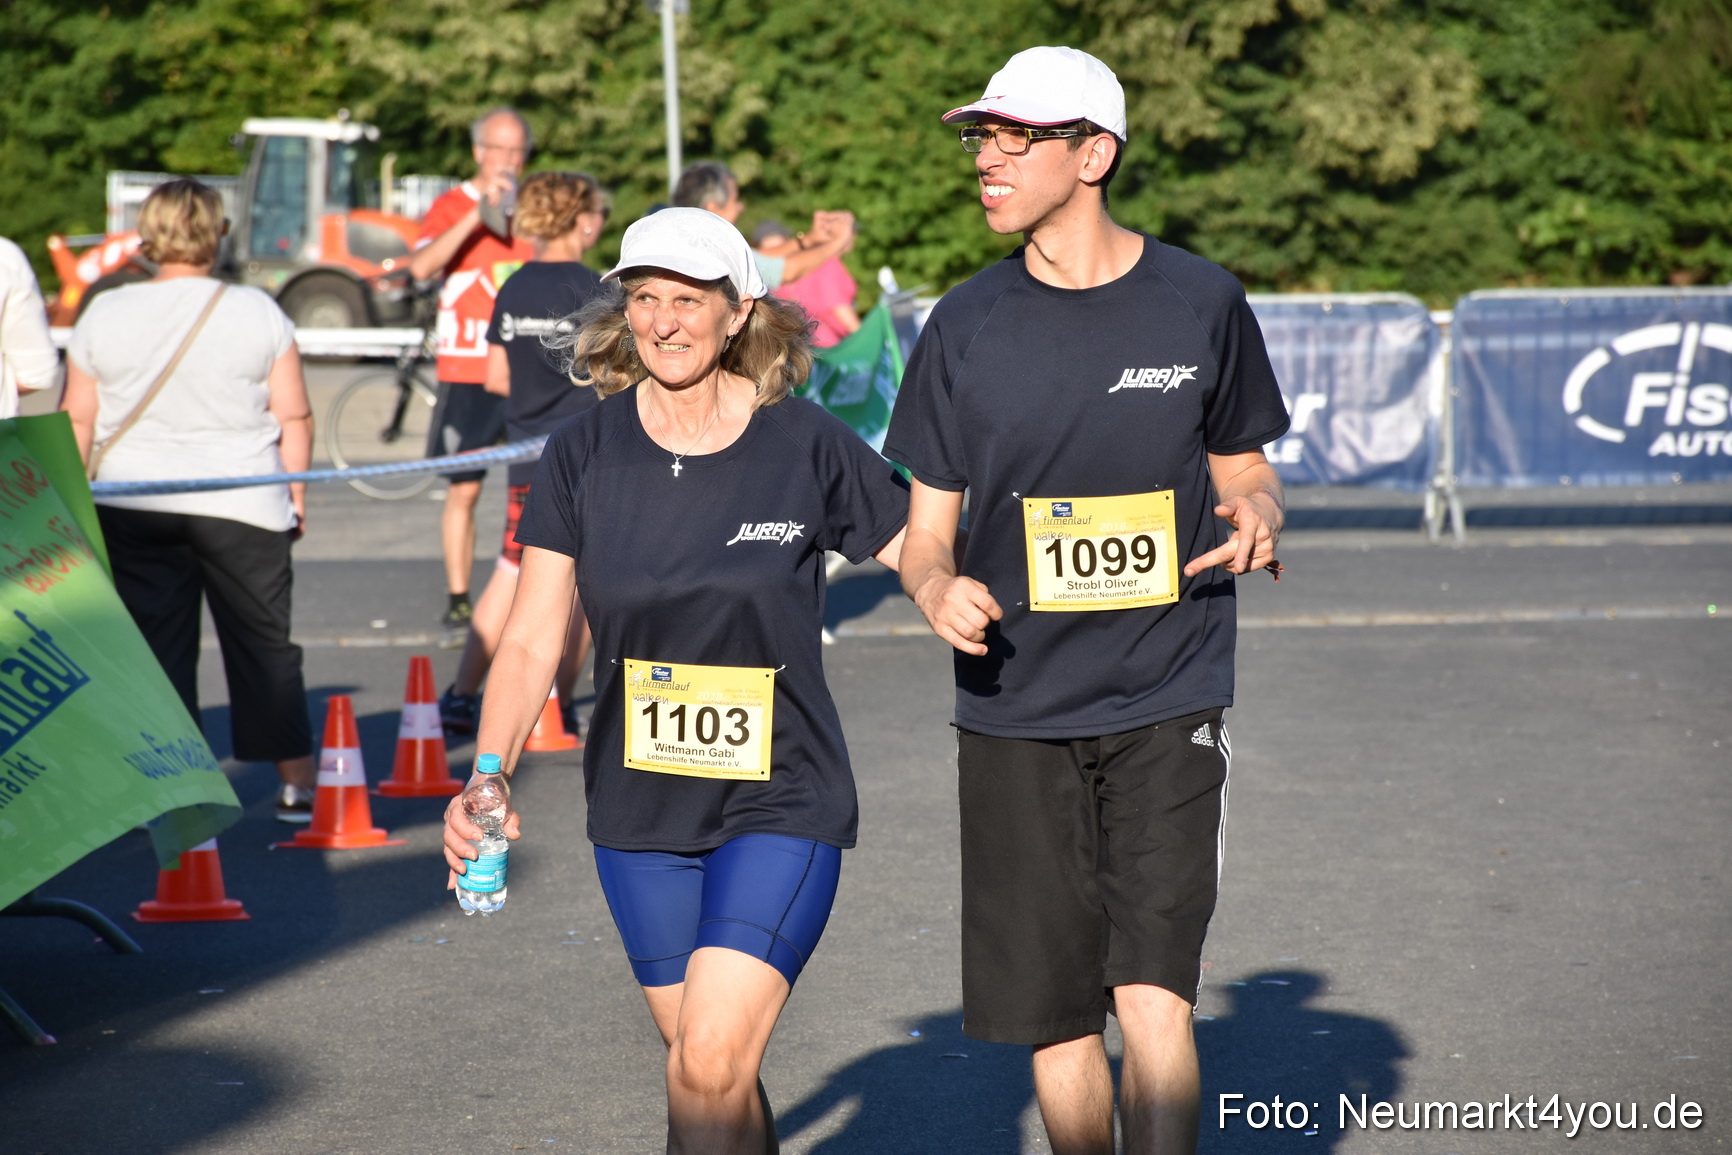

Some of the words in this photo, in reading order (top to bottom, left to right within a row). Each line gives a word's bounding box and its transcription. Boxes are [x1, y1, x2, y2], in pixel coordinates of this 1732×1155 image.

[1108, 368, 1173, 393] JURA
[1624, 372, 1732, 427] Fis
[1043, 515, 1092, 525] firmenlauf
[726, 522, 788, 546] JURA
[1034, 531, 1072, 541] walken
[1045, 534, 1156, 578] 1099
[1067, 580, 1101, 590] Strobl
[1104, 579, 1138, 589] Oliver
[1053, 592, 1097, 600] Lebenshilfe
[1099, 590, 1136, 598] Neumarkt
[642, 678, 691, 691] firmenlauf
[633, 693, 669, 705] walken
[642, 702, 750, 747] 1103
[1191, 736, 1214, 747] adidas
[654, 743, 705, 757] Wittmann
[709, 747, 735, 758] Gabi
[647, 753, 688, 764] Lebenshilfe
[689, 757, 726, 767] Neumarkt
[727, 760, 742, 768] e.V.
